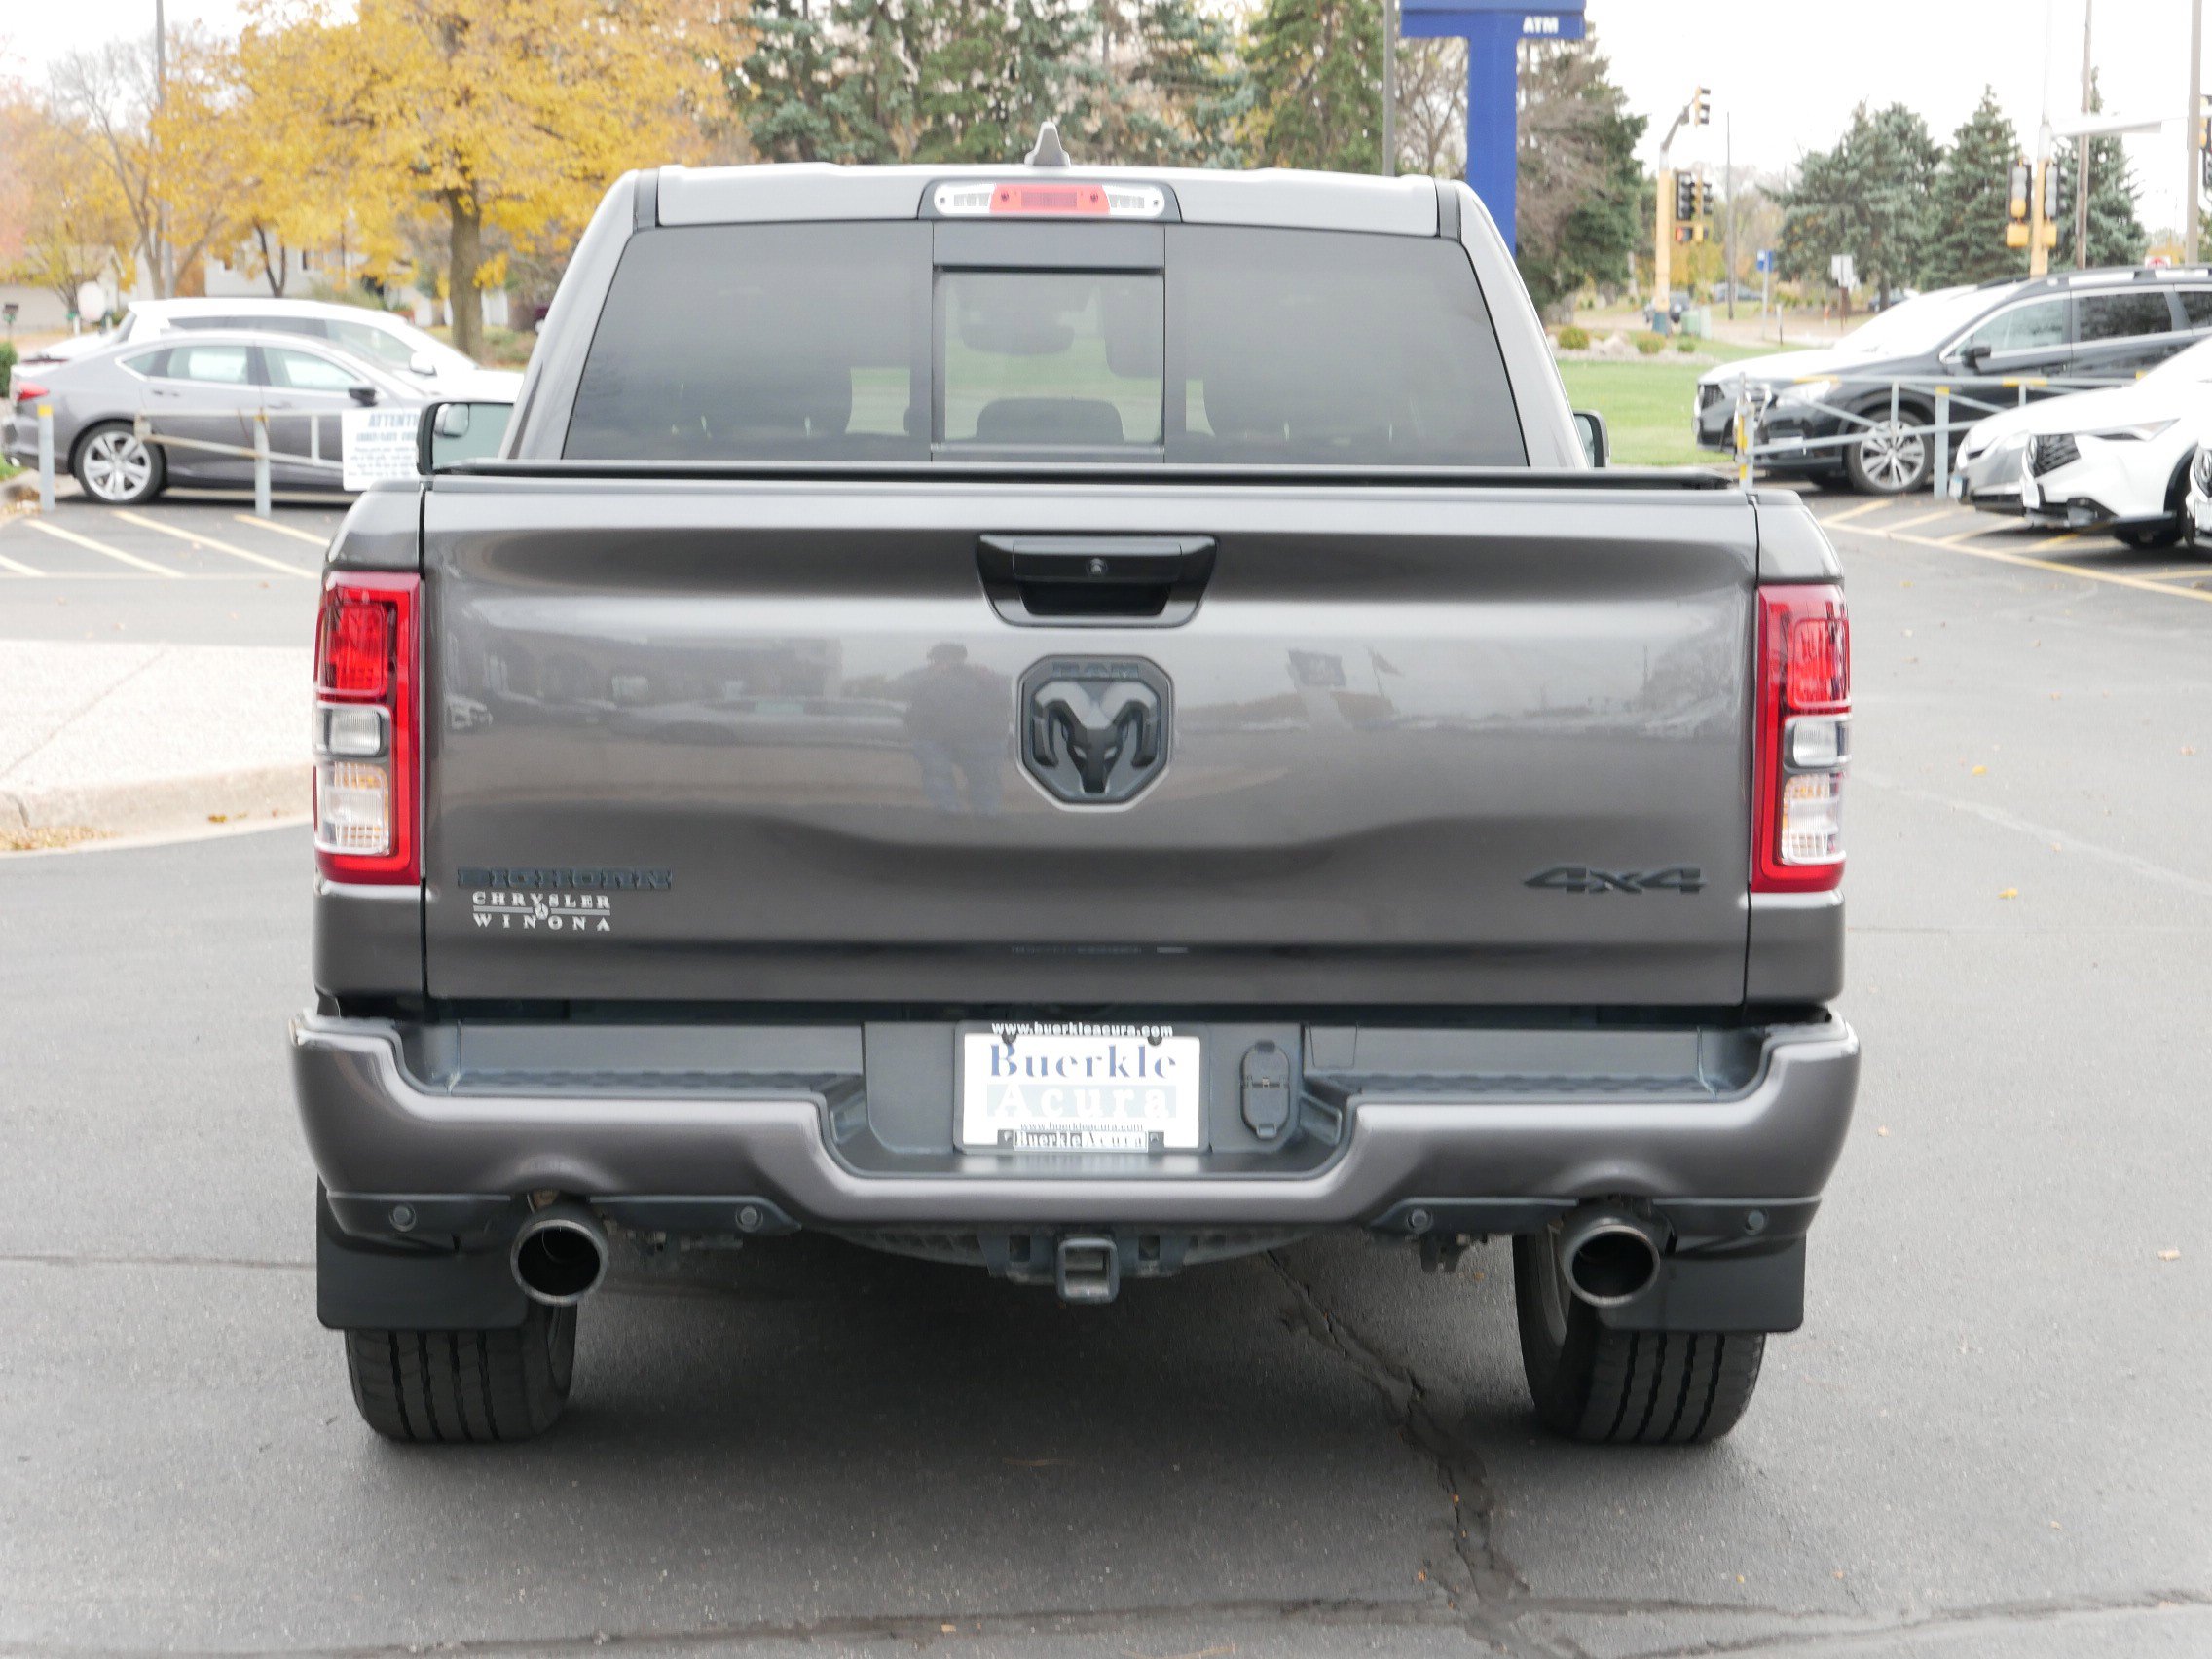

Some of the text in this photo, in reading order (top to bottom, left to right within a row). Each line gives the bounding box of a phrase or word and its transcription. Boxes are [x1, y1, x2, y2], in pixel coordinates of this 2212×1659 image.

[1522, 16, 1559, 34] ATM
[472, 891, 611, 909] CHRYSLER
[472, 913, 611, 932] WINONA
[990, 1044, 1176, 1078] Buerkle
[993, 1083, 1170, 1119] Acura
